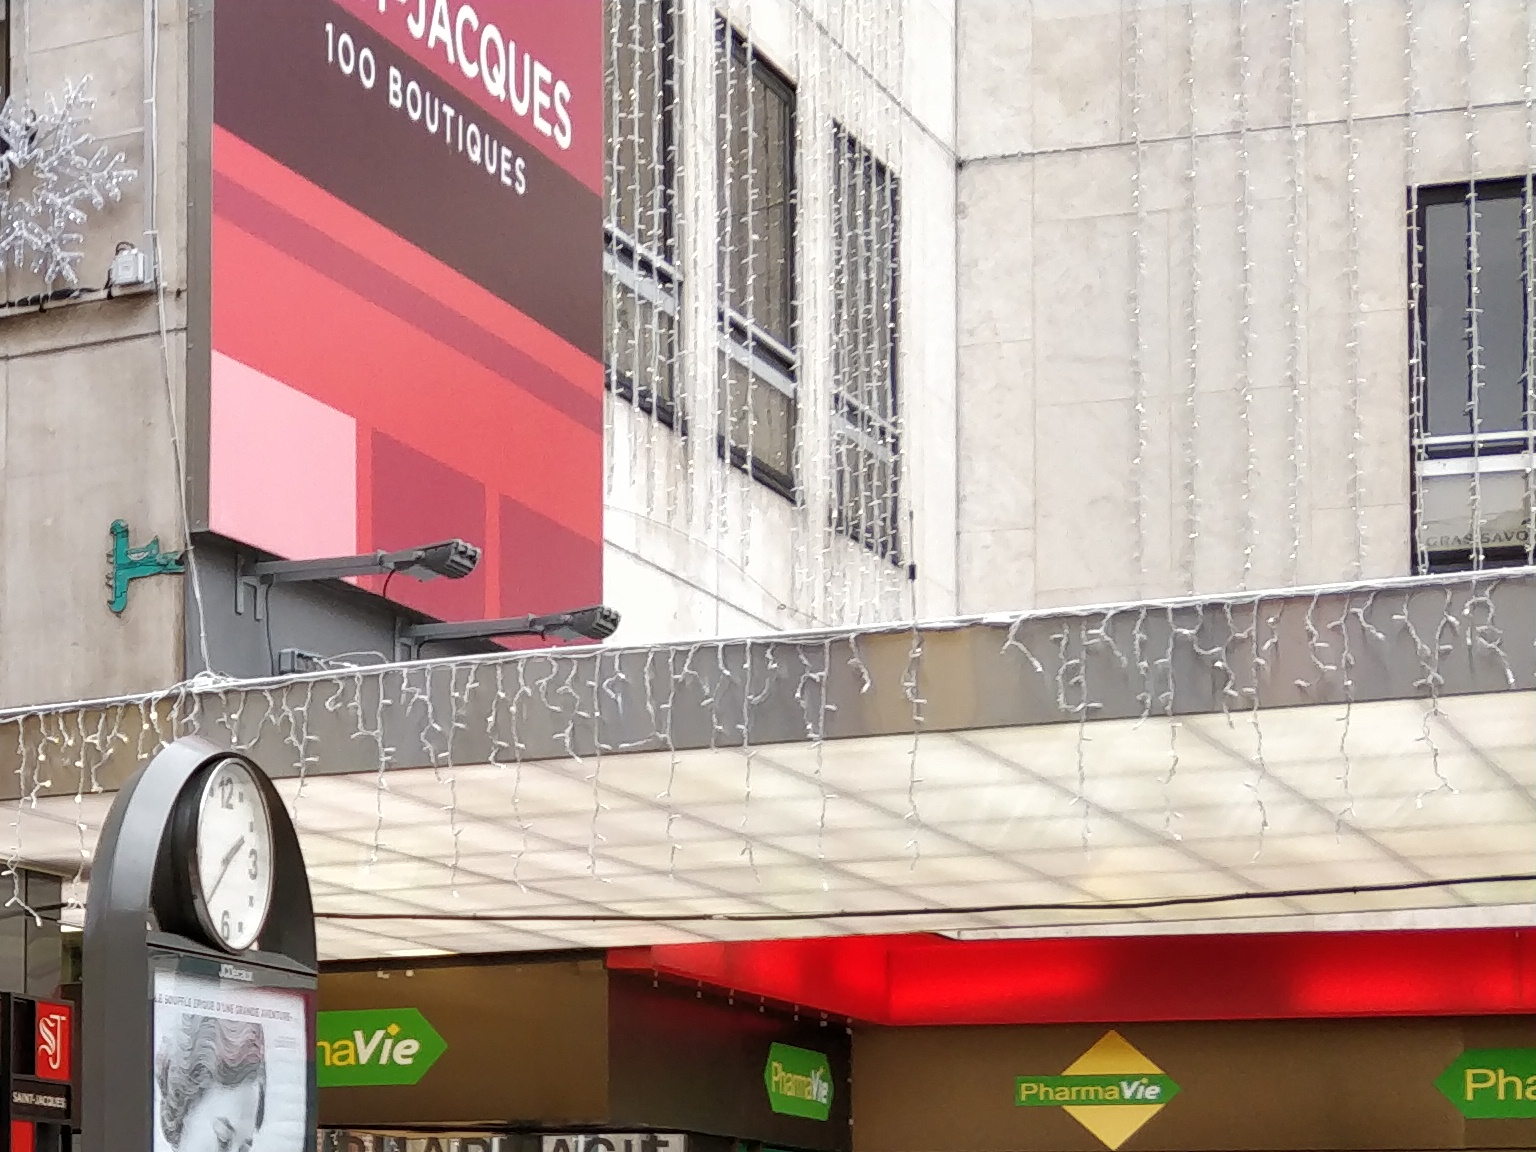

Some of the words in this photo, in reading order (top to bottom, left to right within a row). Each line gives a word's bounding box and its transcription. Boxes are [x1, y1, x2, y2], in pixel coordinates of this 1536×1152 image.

[378, 0, 571, 149] -JACQUES
[325, 22, 376, 89] 100
[388, 66, 526, 195] BOUTIQUES
[218, 776, 234, 811] 12
[247, 848, 258, 881] 3
[221, 910, 230, 941] 6
[771, 1060, 829, 1105] PharmaVie
[1020, 1077, 1161, 1101] PharmaVie
[12, 1091, 67, 1109] SAINT-JACQUES
